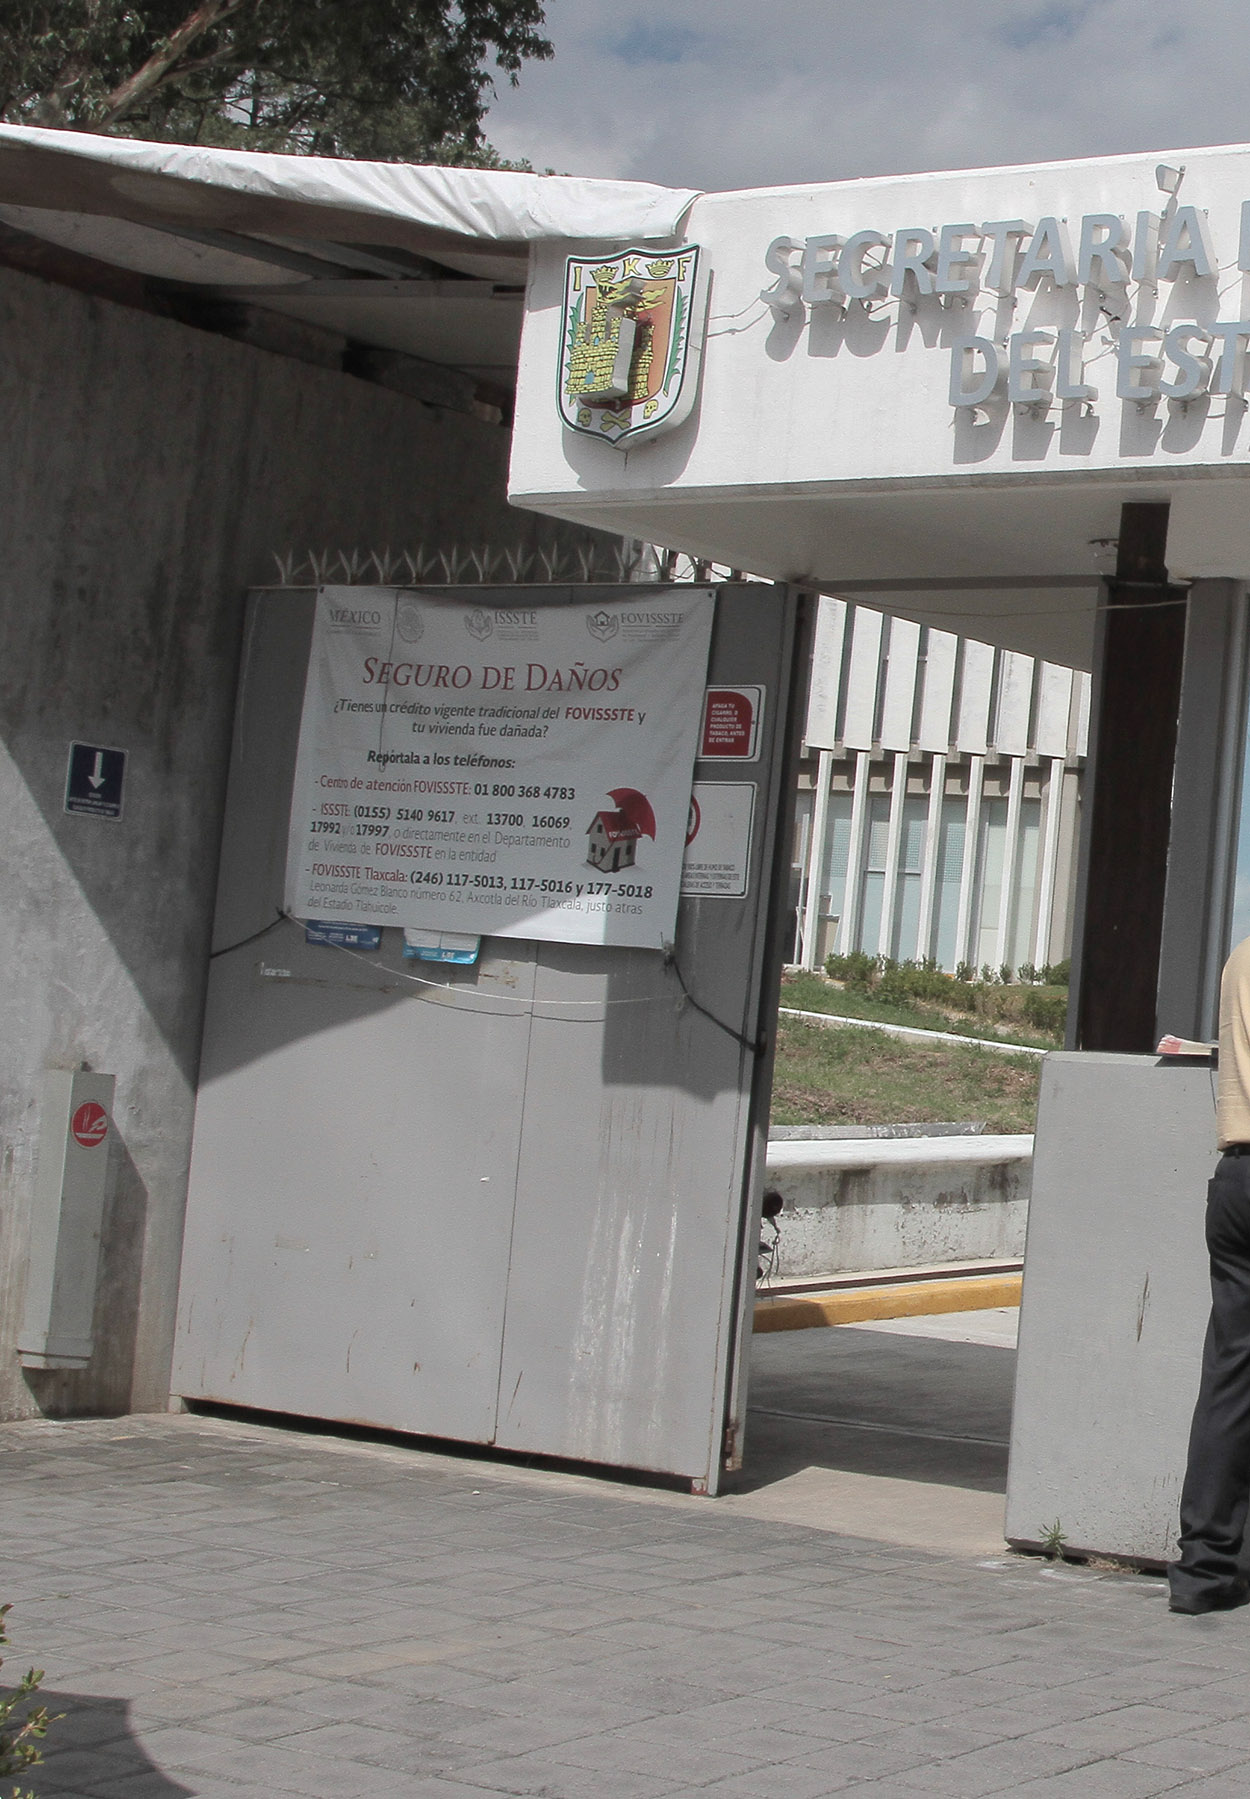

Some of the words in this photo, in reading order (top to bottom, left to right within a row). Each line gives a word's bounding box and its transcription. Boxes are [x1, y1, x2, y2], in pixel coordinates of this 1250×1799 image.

[948, 327, 1098, 407] DEL
[495, 610, 537, 626] ISSSTE
[621, 612, 684, 625] FOVISSSTE
[334, 698, 374, 714] ¿Tienes
[375, 703, 387, 713] un
[389, 700, 431, 716] crédito
[434, 704, 475, 719] vigente
[478, 705, 541, 720] tradicional
[542, 706, 560, 720] del
[565, 707, 635, 722] FOVISSSTE
[637, 711, 647, 725] y
[412, 721, 425, 733] tu
[429, 722, 475, 736] vivienda
[478, 723, 496, 737] fue
[499, 724, 549, 738] dañada?
[367, 750, 421, 766] Repórtala
[433, 752, 451, 766] los
[453, 753, 516, 769] teléfonos:
[320, 774, 348, 789] Centro
[350, 776, 364, 790] de
[366, 778, 412, 793] atención
[413, 780, 472, 796] FOVISSSTE:
[474, 783, 488, 797] 01
[492, 783, 515, 798] 800
[517, 785, 540, 799] 368
[543, 786, 576, 801] 4783
[353, 804, 391, 820] (0155)
[396, 808, 423, 822] 5140
[310, 821, 341, 835] 17992
[402, 826, 466, 843] directamente
[467, 832, 481, 844] en
[482, 831, 491, 844] el
[495, 831, 571, 849] Departamento
[308, 839, 320, 851] de
[360, 842, 371, 854] de
[375, 842, 433, 859] FOVISSSTE
[434, 849, 447, 859] en
[448, 848, 457, 860] la
[459, 849, 496, 863] entidad
[312, 863, 361, 879] FOVISSSTE
[364, 867, 408, 883] Tlaxcala:
[410, 870, 443, 886] (246)
[446, 873, 507, 890] 117-5013,
[510, 876, 573, 894] 117-5016
[576, 883, 584, 897] y
[586, 881, 653, 899] 177-5018
[307, 896, 320, 908] del
[410, 887, 447, 901] número
[467, 891, 503, 905] Axcotla
[507, 892, 521, 907] del
[523, 893, 537, 908] Río
[541, 895, 584, 912] Tlaxcala,
[585, 899, 613, 915] justo
[615, 901, 643, 915] atras
